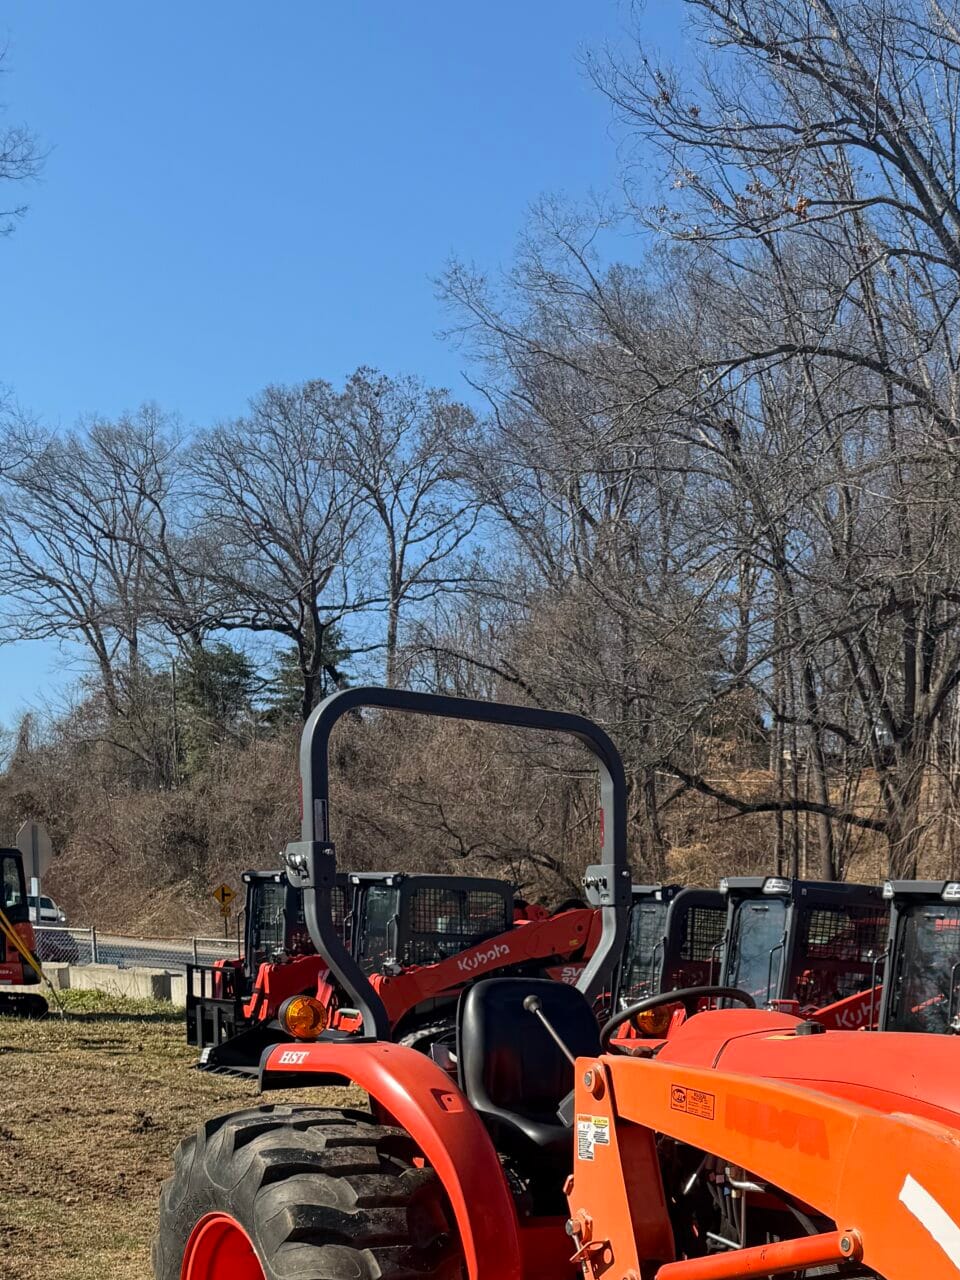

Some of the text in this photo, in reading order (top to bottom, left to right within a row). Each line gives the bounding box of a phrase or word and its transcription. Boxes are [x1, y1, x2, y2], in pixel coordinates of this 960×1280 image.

[457, 943, 510, 971] Kubota
[561, 967, 584, 977] SV
[278, 1051, 311, 1065] HST
